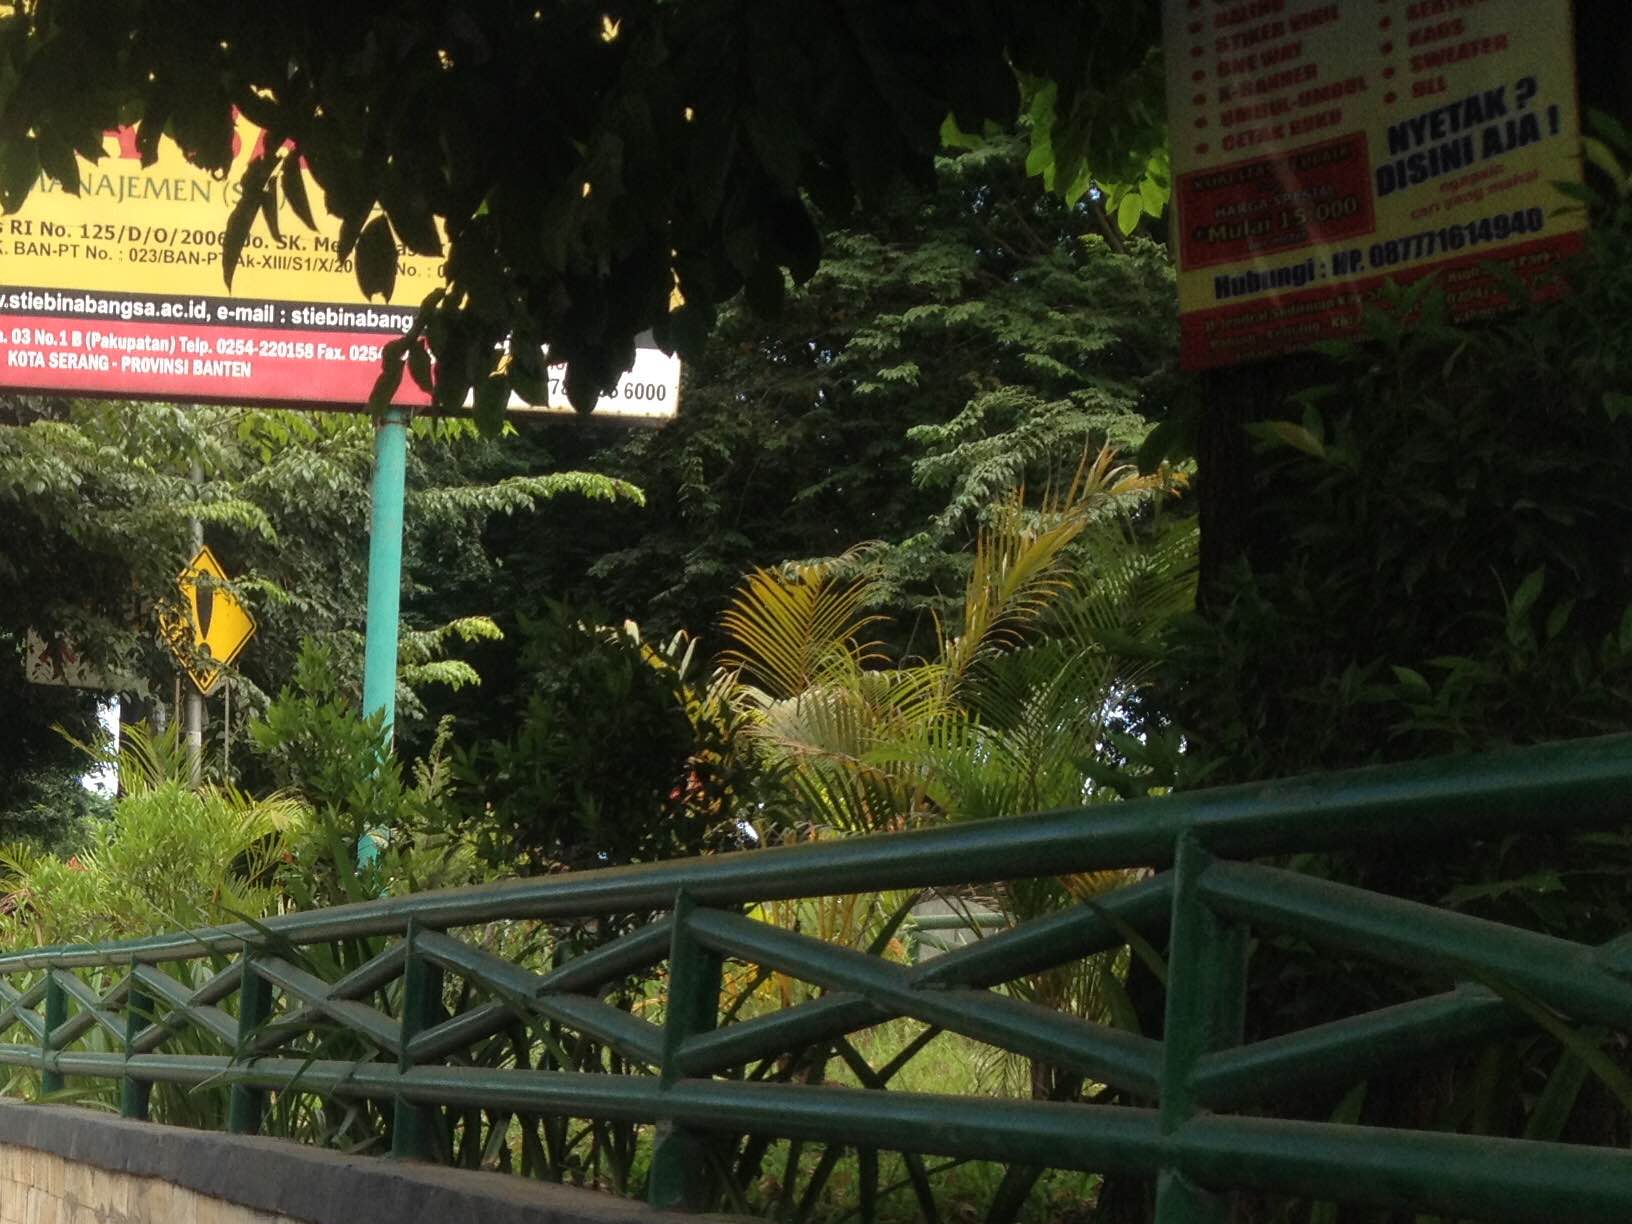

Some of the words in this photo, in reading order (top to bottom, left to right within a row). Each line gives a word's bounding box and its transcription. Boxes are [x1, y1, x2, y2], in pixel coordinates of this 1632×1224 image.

[1410, 33, 1509, 72] SWEATER
[1387, 86, 1508, 156] NYETAK
[1515, 75, 1537, 110] ?
[1377, 135, 1474, 197] DISINI
[1482, 112, 1541, 160] AJA
[38, 170, 211, 204] ANAJEMEN
[10, 220, 32, 236] RI
[40, 221, 72, 239] No.
[276, 235, 306, 251] SK.
[14, 241, 80, 259] BAN-PT
[86, 246, 113, 261] No.
[1214, 257, 1315, 298] Hubungi
[217, 304, 274, 323] e-mail
[11, 328, 31, 344] 03
[71, 331, 82, 347] B
[86, 331, 176, 353] (Pakupatan)
[179, 336, 213, 356] Telp.
[217, 338, 313, 359] 0254-220158
[317, 344, 345, 361] Fax.
[8, 350, 45, 368] KOTA
[49, 352, 109, 372] SERANG
[121, 356, 189, 375] PROVINSI
[193, 359, 251, 378] BANTEN
